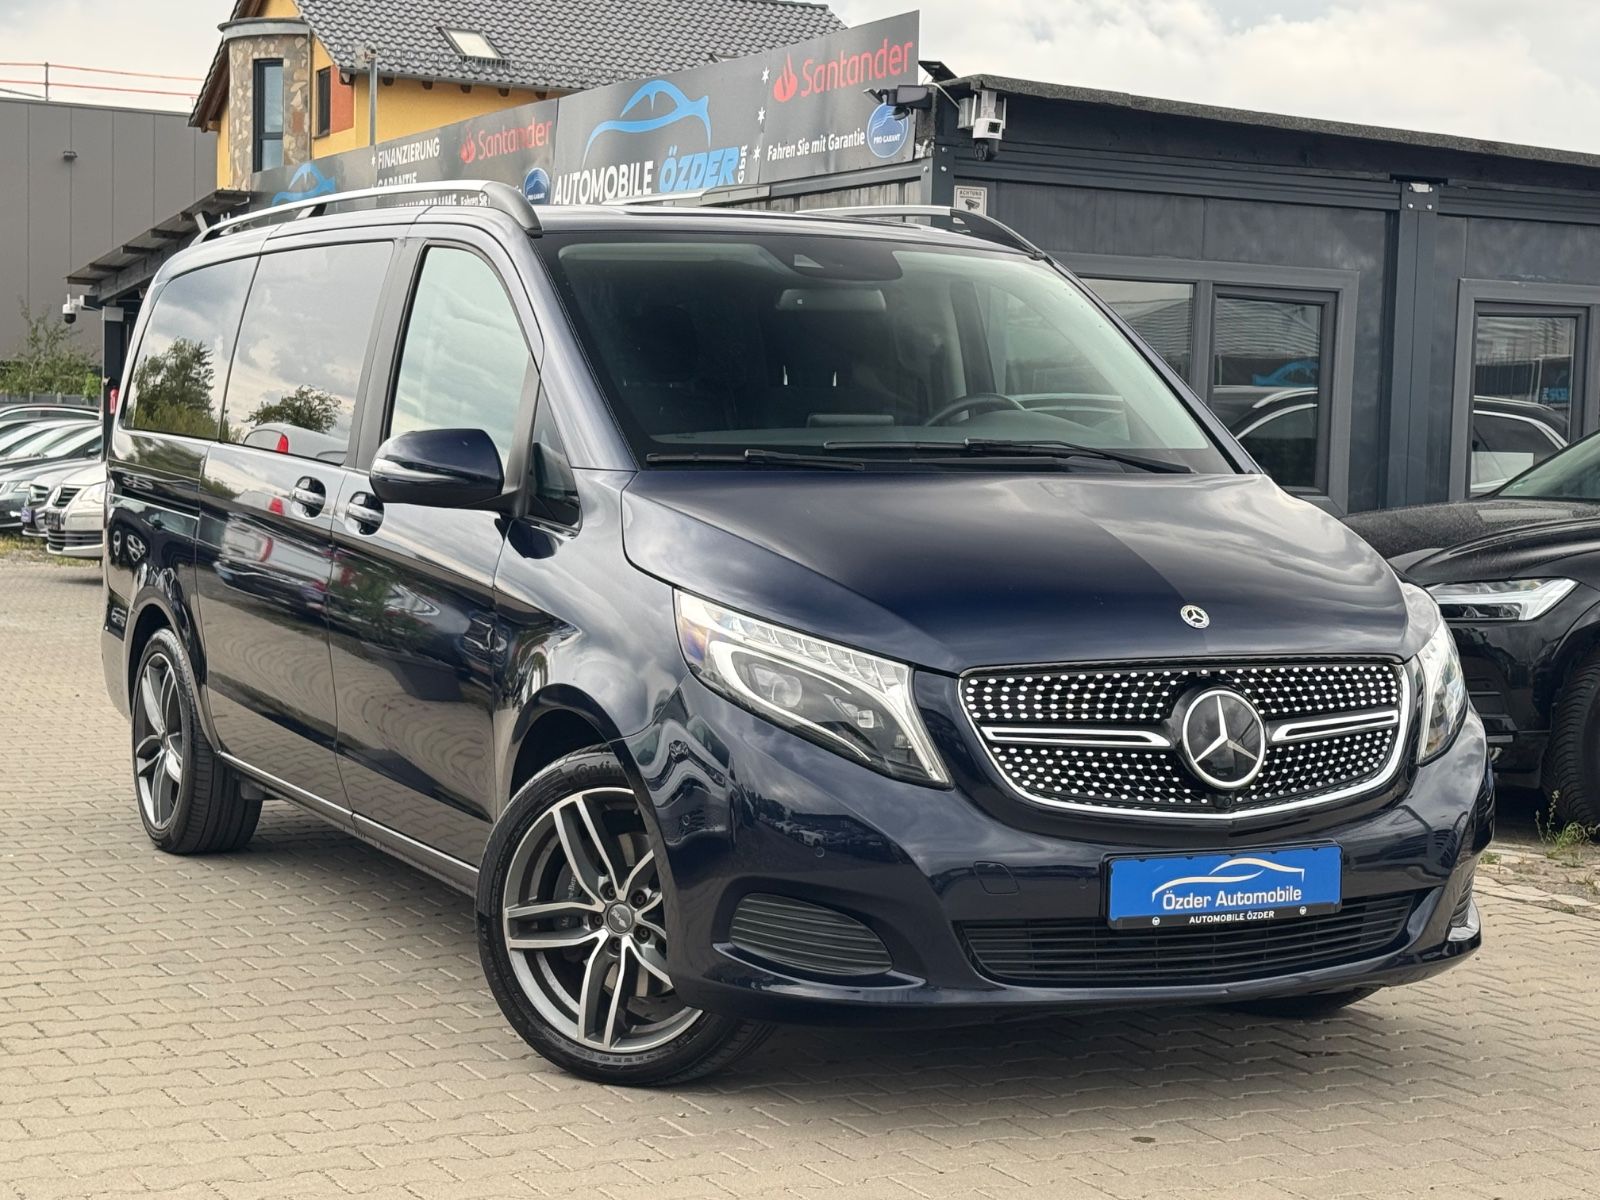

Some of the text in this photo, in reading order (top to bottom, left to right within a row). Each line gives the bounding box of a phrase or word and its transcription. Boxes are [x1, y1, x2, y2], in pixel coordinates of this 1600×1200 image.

[800, 38, 914, 97] Santander
[377, 137, 440, 170] FINANZIERUNG
[478, 116, 552, 161] Santander
[767, 128, 866, 161] Fahren Sie mit Garantie
[553, 160, 655, 206] AUTOMOBILE
[659, 145, 740, 193] ÖZDER
[1162, 886, 1302, 911] Özder Automobile
[1188, 910, 1276, 924] AUTOMOBILE ÖZDER
